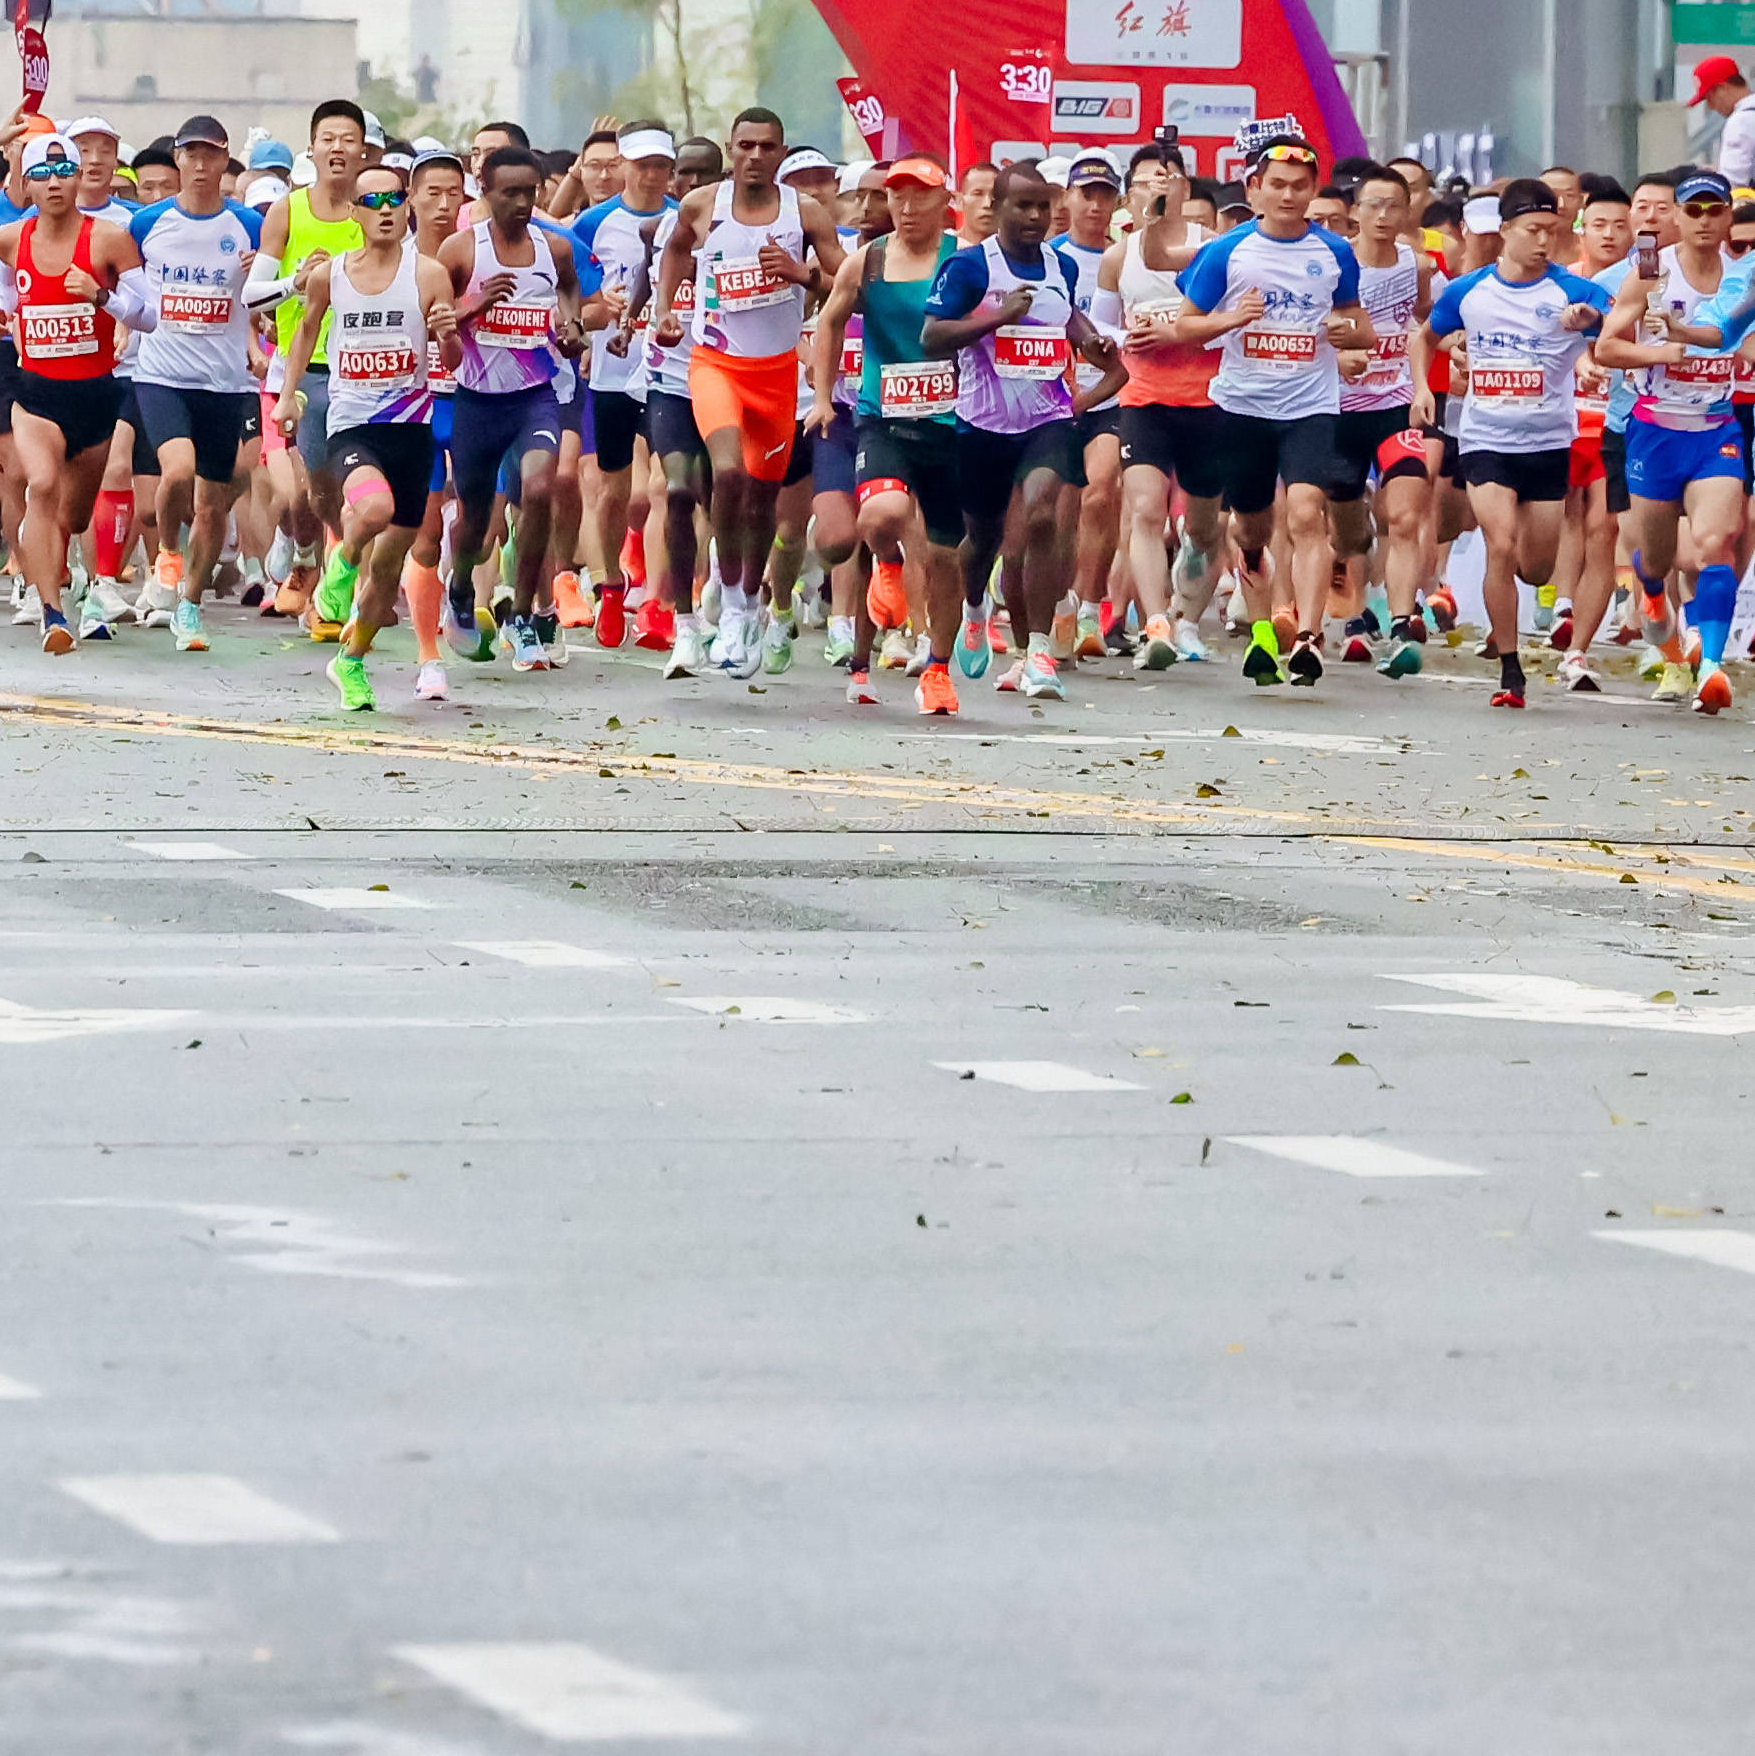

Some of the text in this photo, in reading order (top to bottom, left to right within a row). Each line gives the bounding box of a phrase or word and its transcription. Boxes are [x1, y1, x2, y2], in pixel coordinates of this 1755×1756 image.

[1114, 0, 1193, 39] 红旗
[999, 62, 1051, 95] 3:30
[157, 263, 228, 285] 中国警察
[25, 316, 95, 338] A00513
[343, 310, 405, 329] 夜跑营
[1013, 340, 1056, 358] TONA
[339, 350, 411, 374] A00637
[884, 373, 954, 398] A02799
